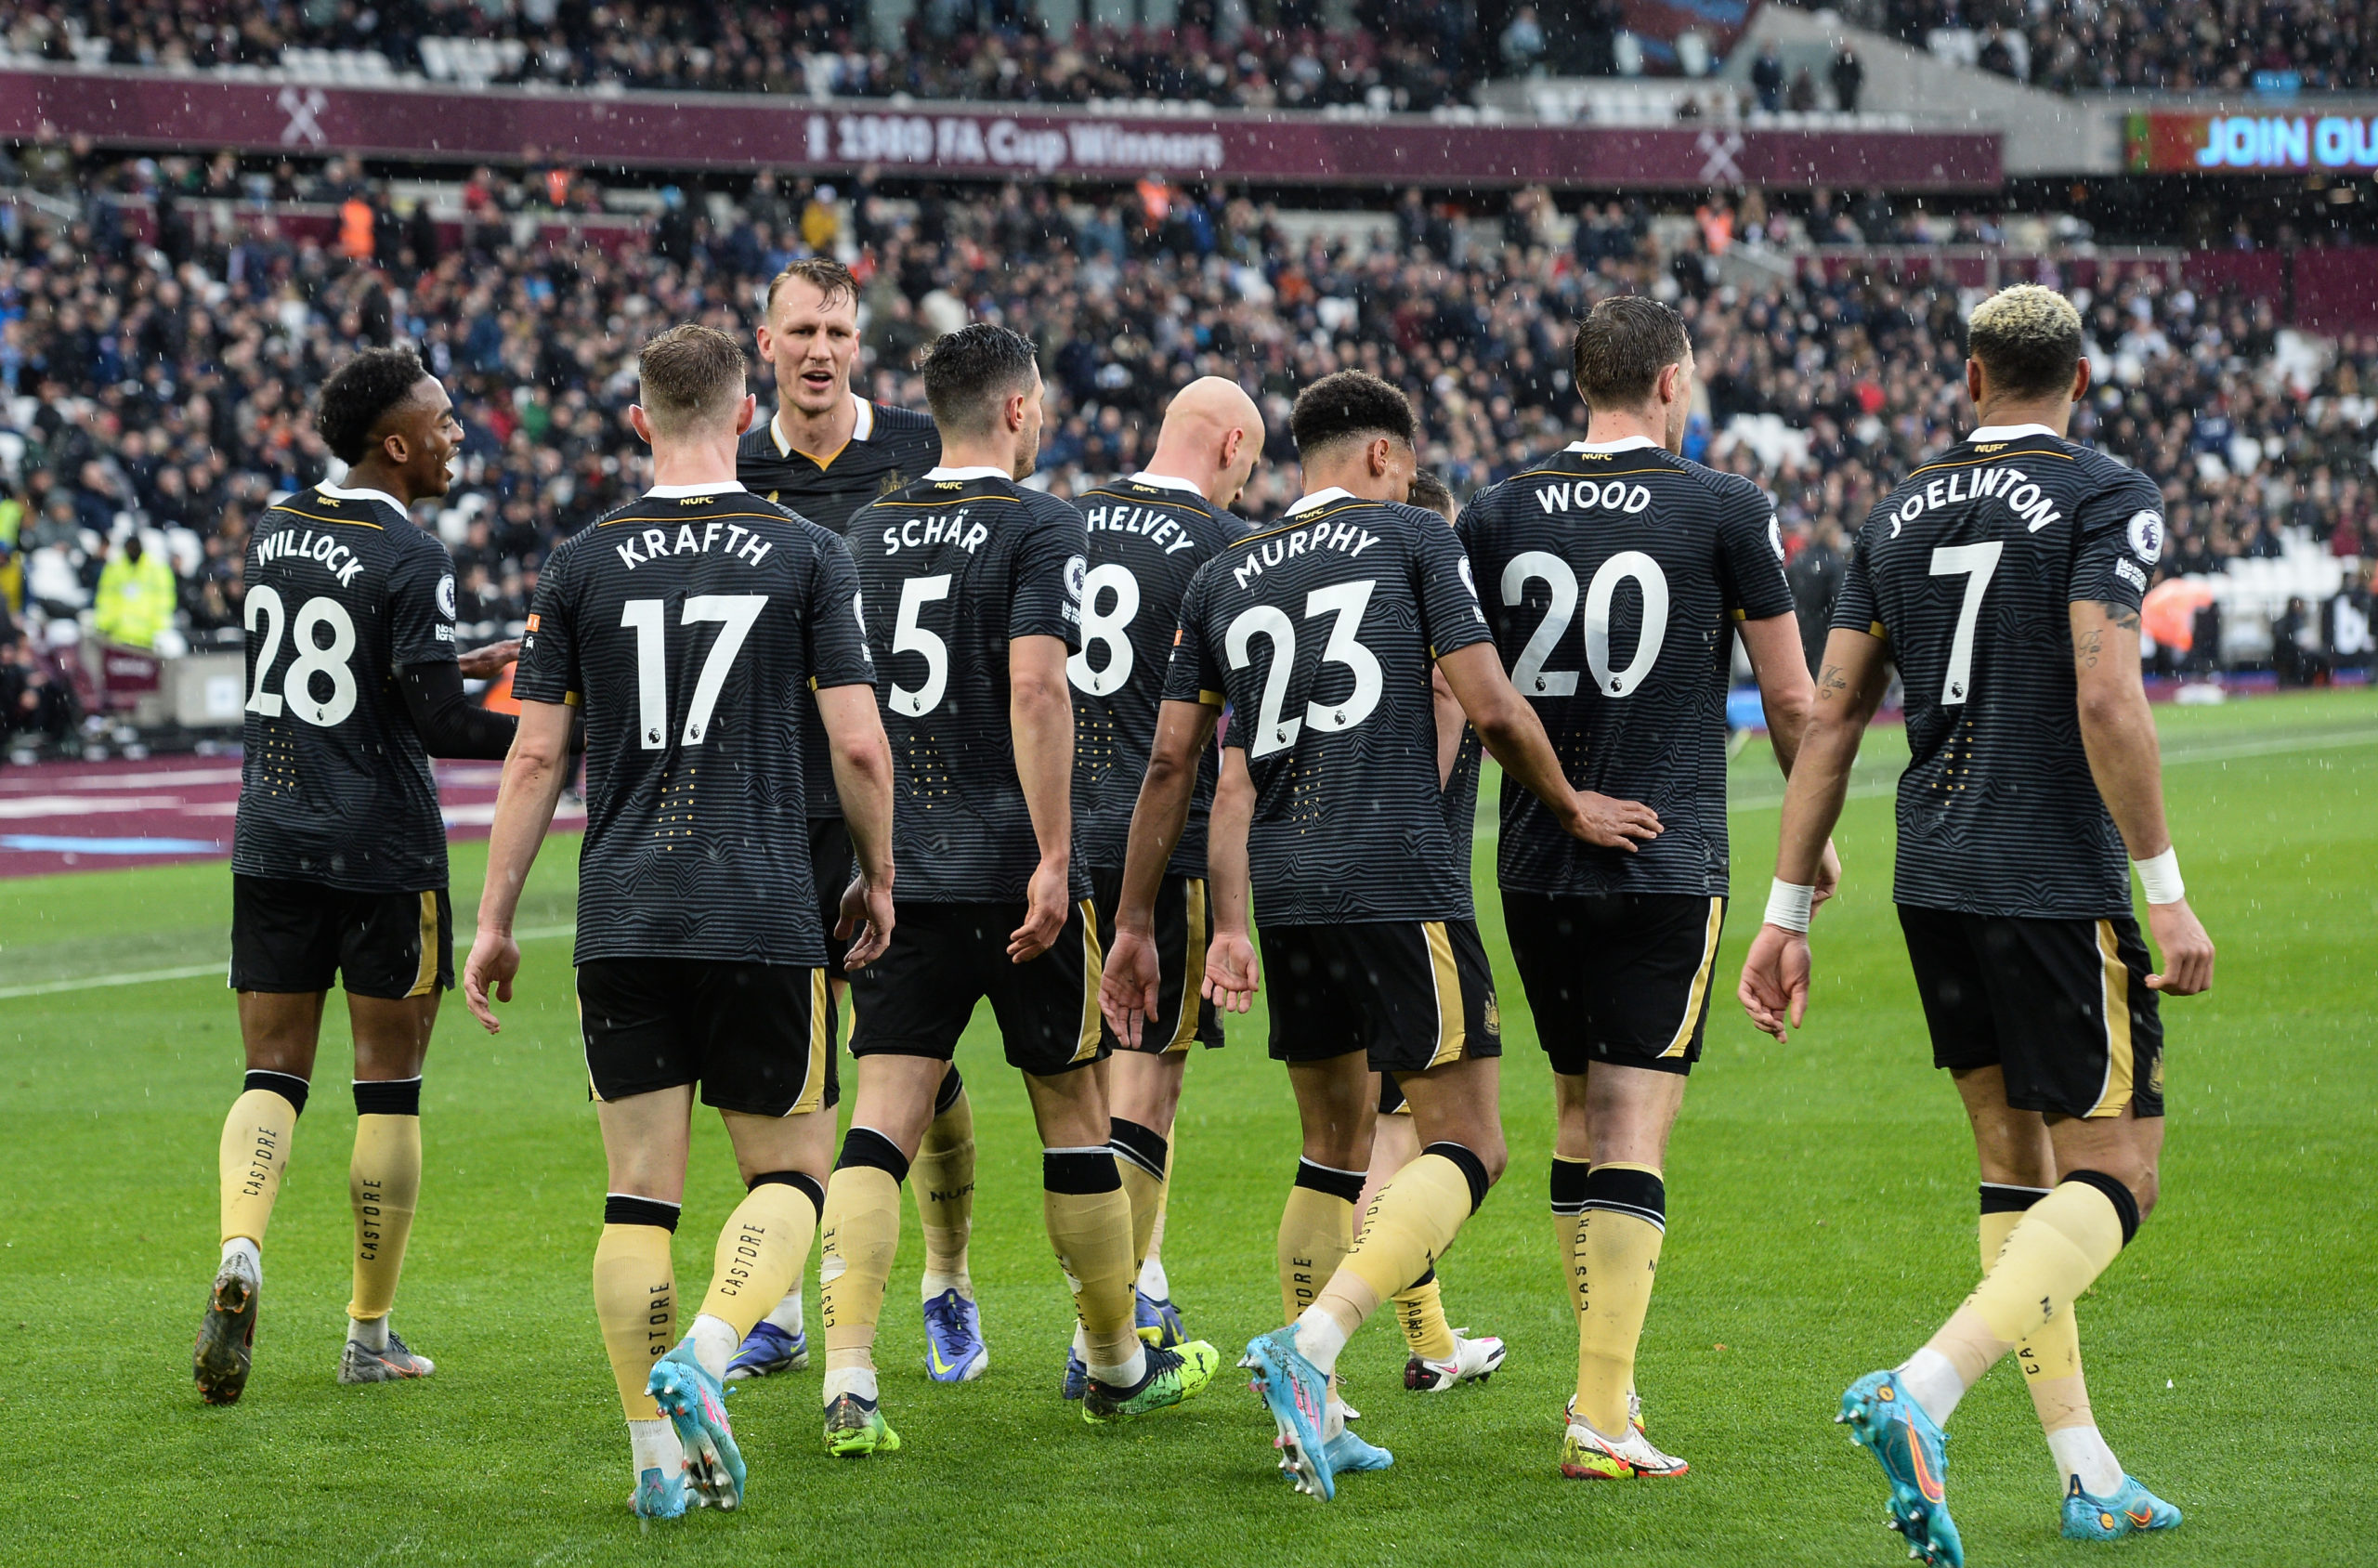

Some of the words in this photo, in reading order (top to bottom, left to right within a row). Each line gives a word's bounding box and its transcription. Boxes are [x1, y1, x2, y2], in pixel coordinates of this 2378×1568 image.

[935, 118, 986, 163] FA
[986, 120, 1067, 175] Cup
[1068, 123, 1224, 169] Winners
[2195, 116, 2308, 166] JOIN
[680, 495, 713, 506] NUFC
[934, 481, 963, 490] NUFC
[1535, 480, 1651, 514] WOOD
[1887, 467, 2061, 539] JOELINTON
[256, 529, 364, 588] WILLOCK
[615, 522, 772, 570] KRAFTH
[882, 508, 987, 556] SCHÄR
[1087, 506, 1195, 555] HELVEY
[1233, 522, 1380, 590] MURPHY
[244, 584, 357, 727] 28
[888, 573, 952, 717] 5
[1066, 564, 1140, 697] 8
[1501, 551, 1669, 697] 20
[1929, 541, 2004, 705] 7
[620, 595, 769, 750] 17
[1224, 580, 1383, 758] 23
[243, 1127, 277, 1196] CASTORE
[360, 1180, 381, 1261] CASTORE
[721, 1223, 765, 1296] CASTORE
[821, 1227, 836, 1328] CASTRE
[1292, 1257, 1313, 1316] TORE
[1574, 1209, 1592, 1312] CASTOR
[648, 1282, 670, 1362] STORE
